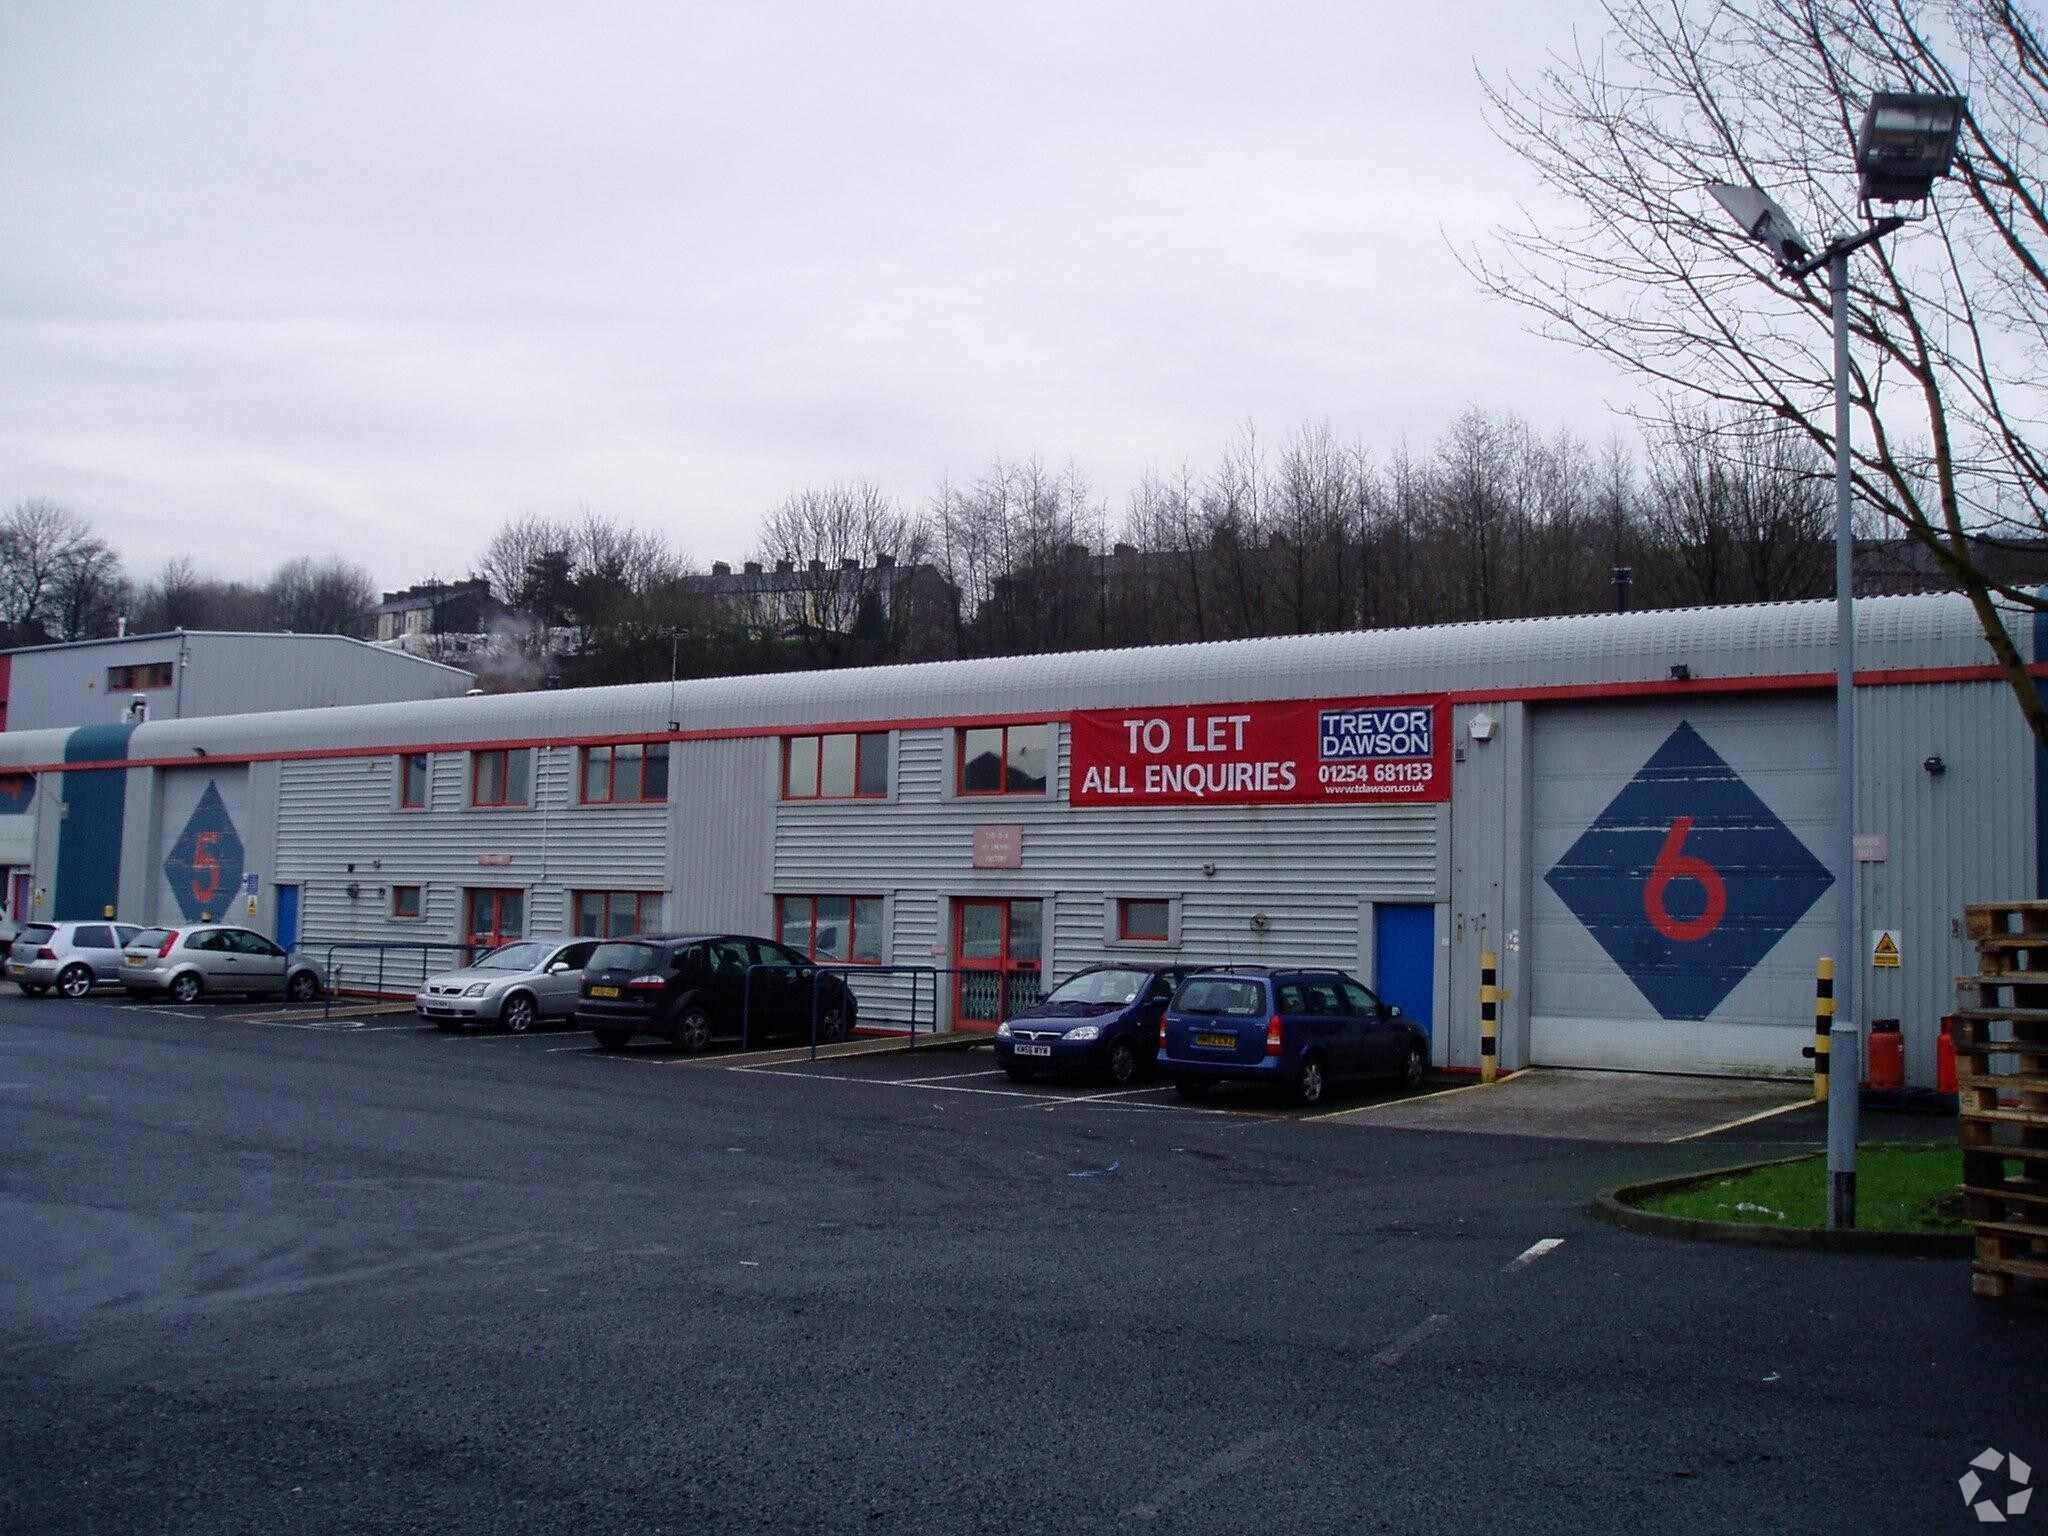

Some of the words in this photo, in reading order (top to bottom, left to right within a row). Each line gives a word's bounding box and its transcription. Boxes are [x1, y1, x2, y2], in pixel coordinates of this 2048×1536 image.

[1123, 718, 1171, 754] TO
[1187, 714, 1251, 752] LET
[1323, 711, 1427, 734] TREVOR
[1323, 732, 1429, 755] DAWSON
[1081, 766, 1134, 794] ALL
[1145, 761, 1296, 797] ENQUIRIES
[1318, 764, 1369, 783] 01254
[1374, 763, 1433, 782] 681133
[192, 831, 221, 903] 5
[1643, 815, 1728, 942] 6
